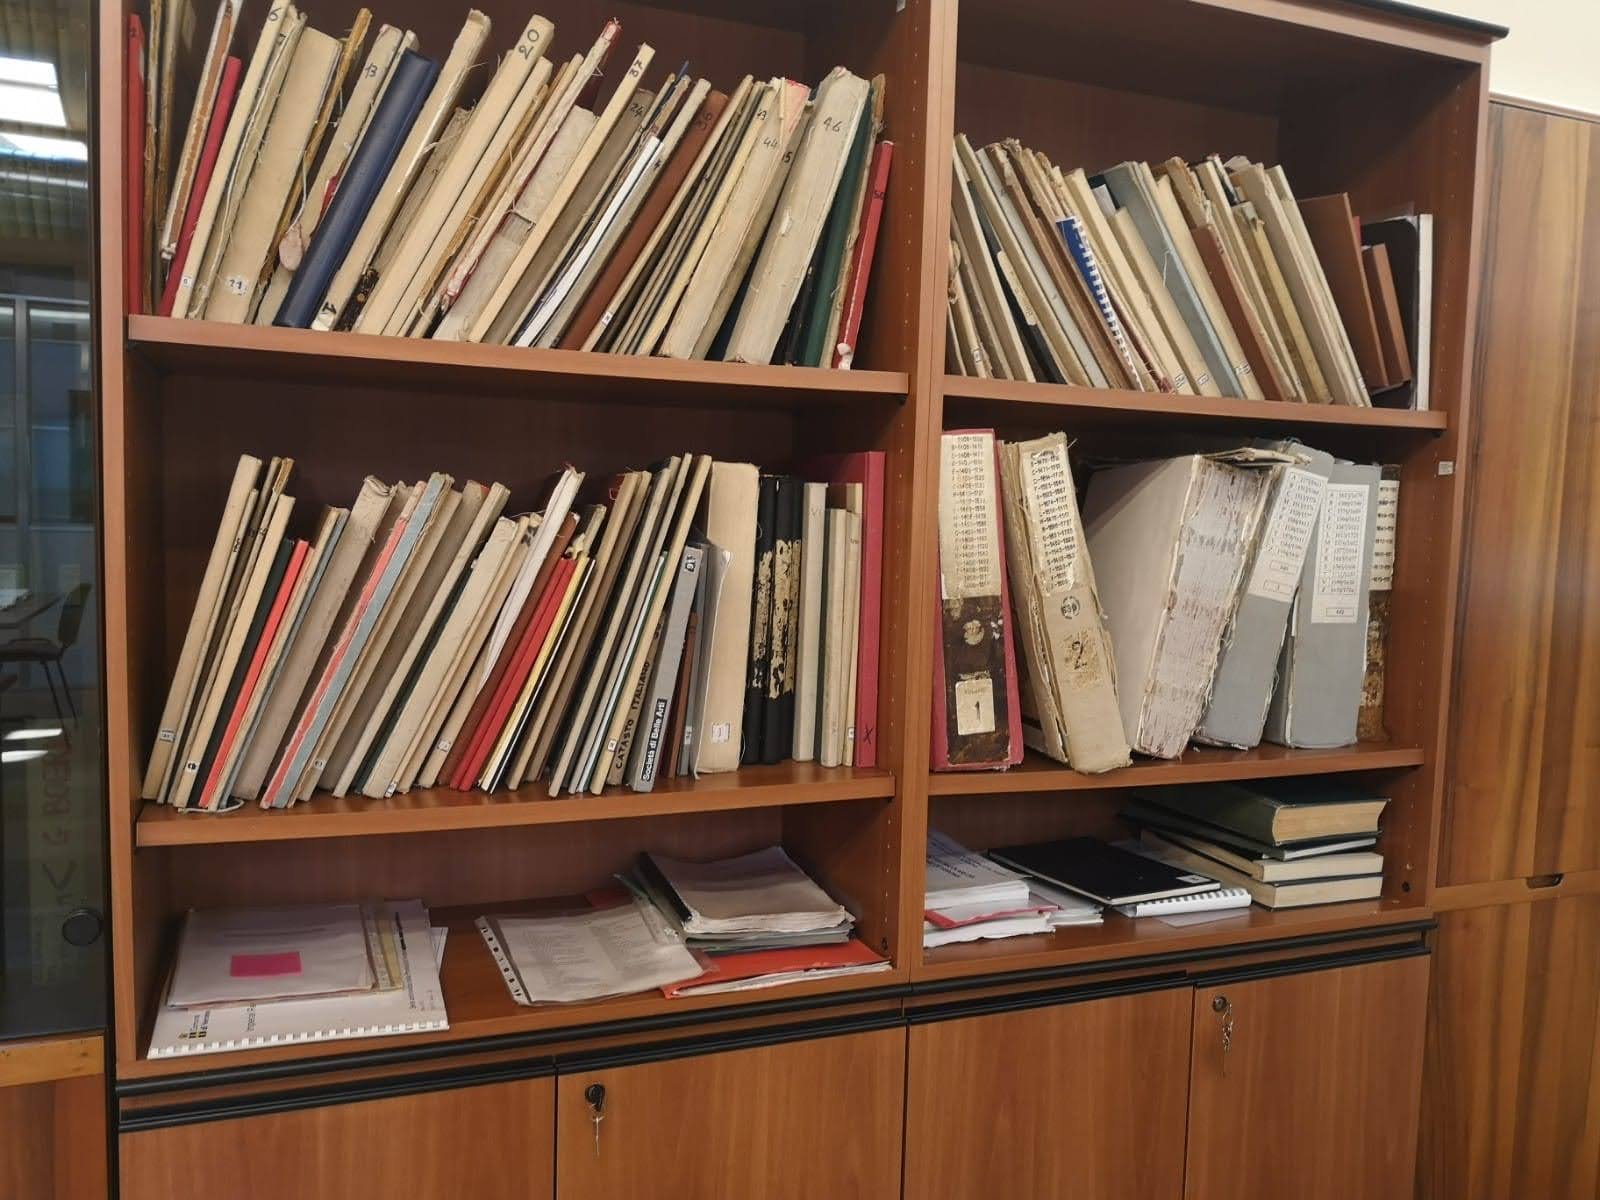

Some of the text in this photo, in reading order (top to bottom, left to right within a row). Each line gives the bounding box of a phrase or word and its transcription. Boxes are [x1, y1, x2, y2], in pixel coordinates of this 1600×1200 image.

[268, 8, 281, 21] 6
[518, 29, 540, 60] 20
[616, 661, 651, 769] CATASTO ITALIANO
[656, 701, 666, 717] Arti
[651, 718, 662, 738] Belle
